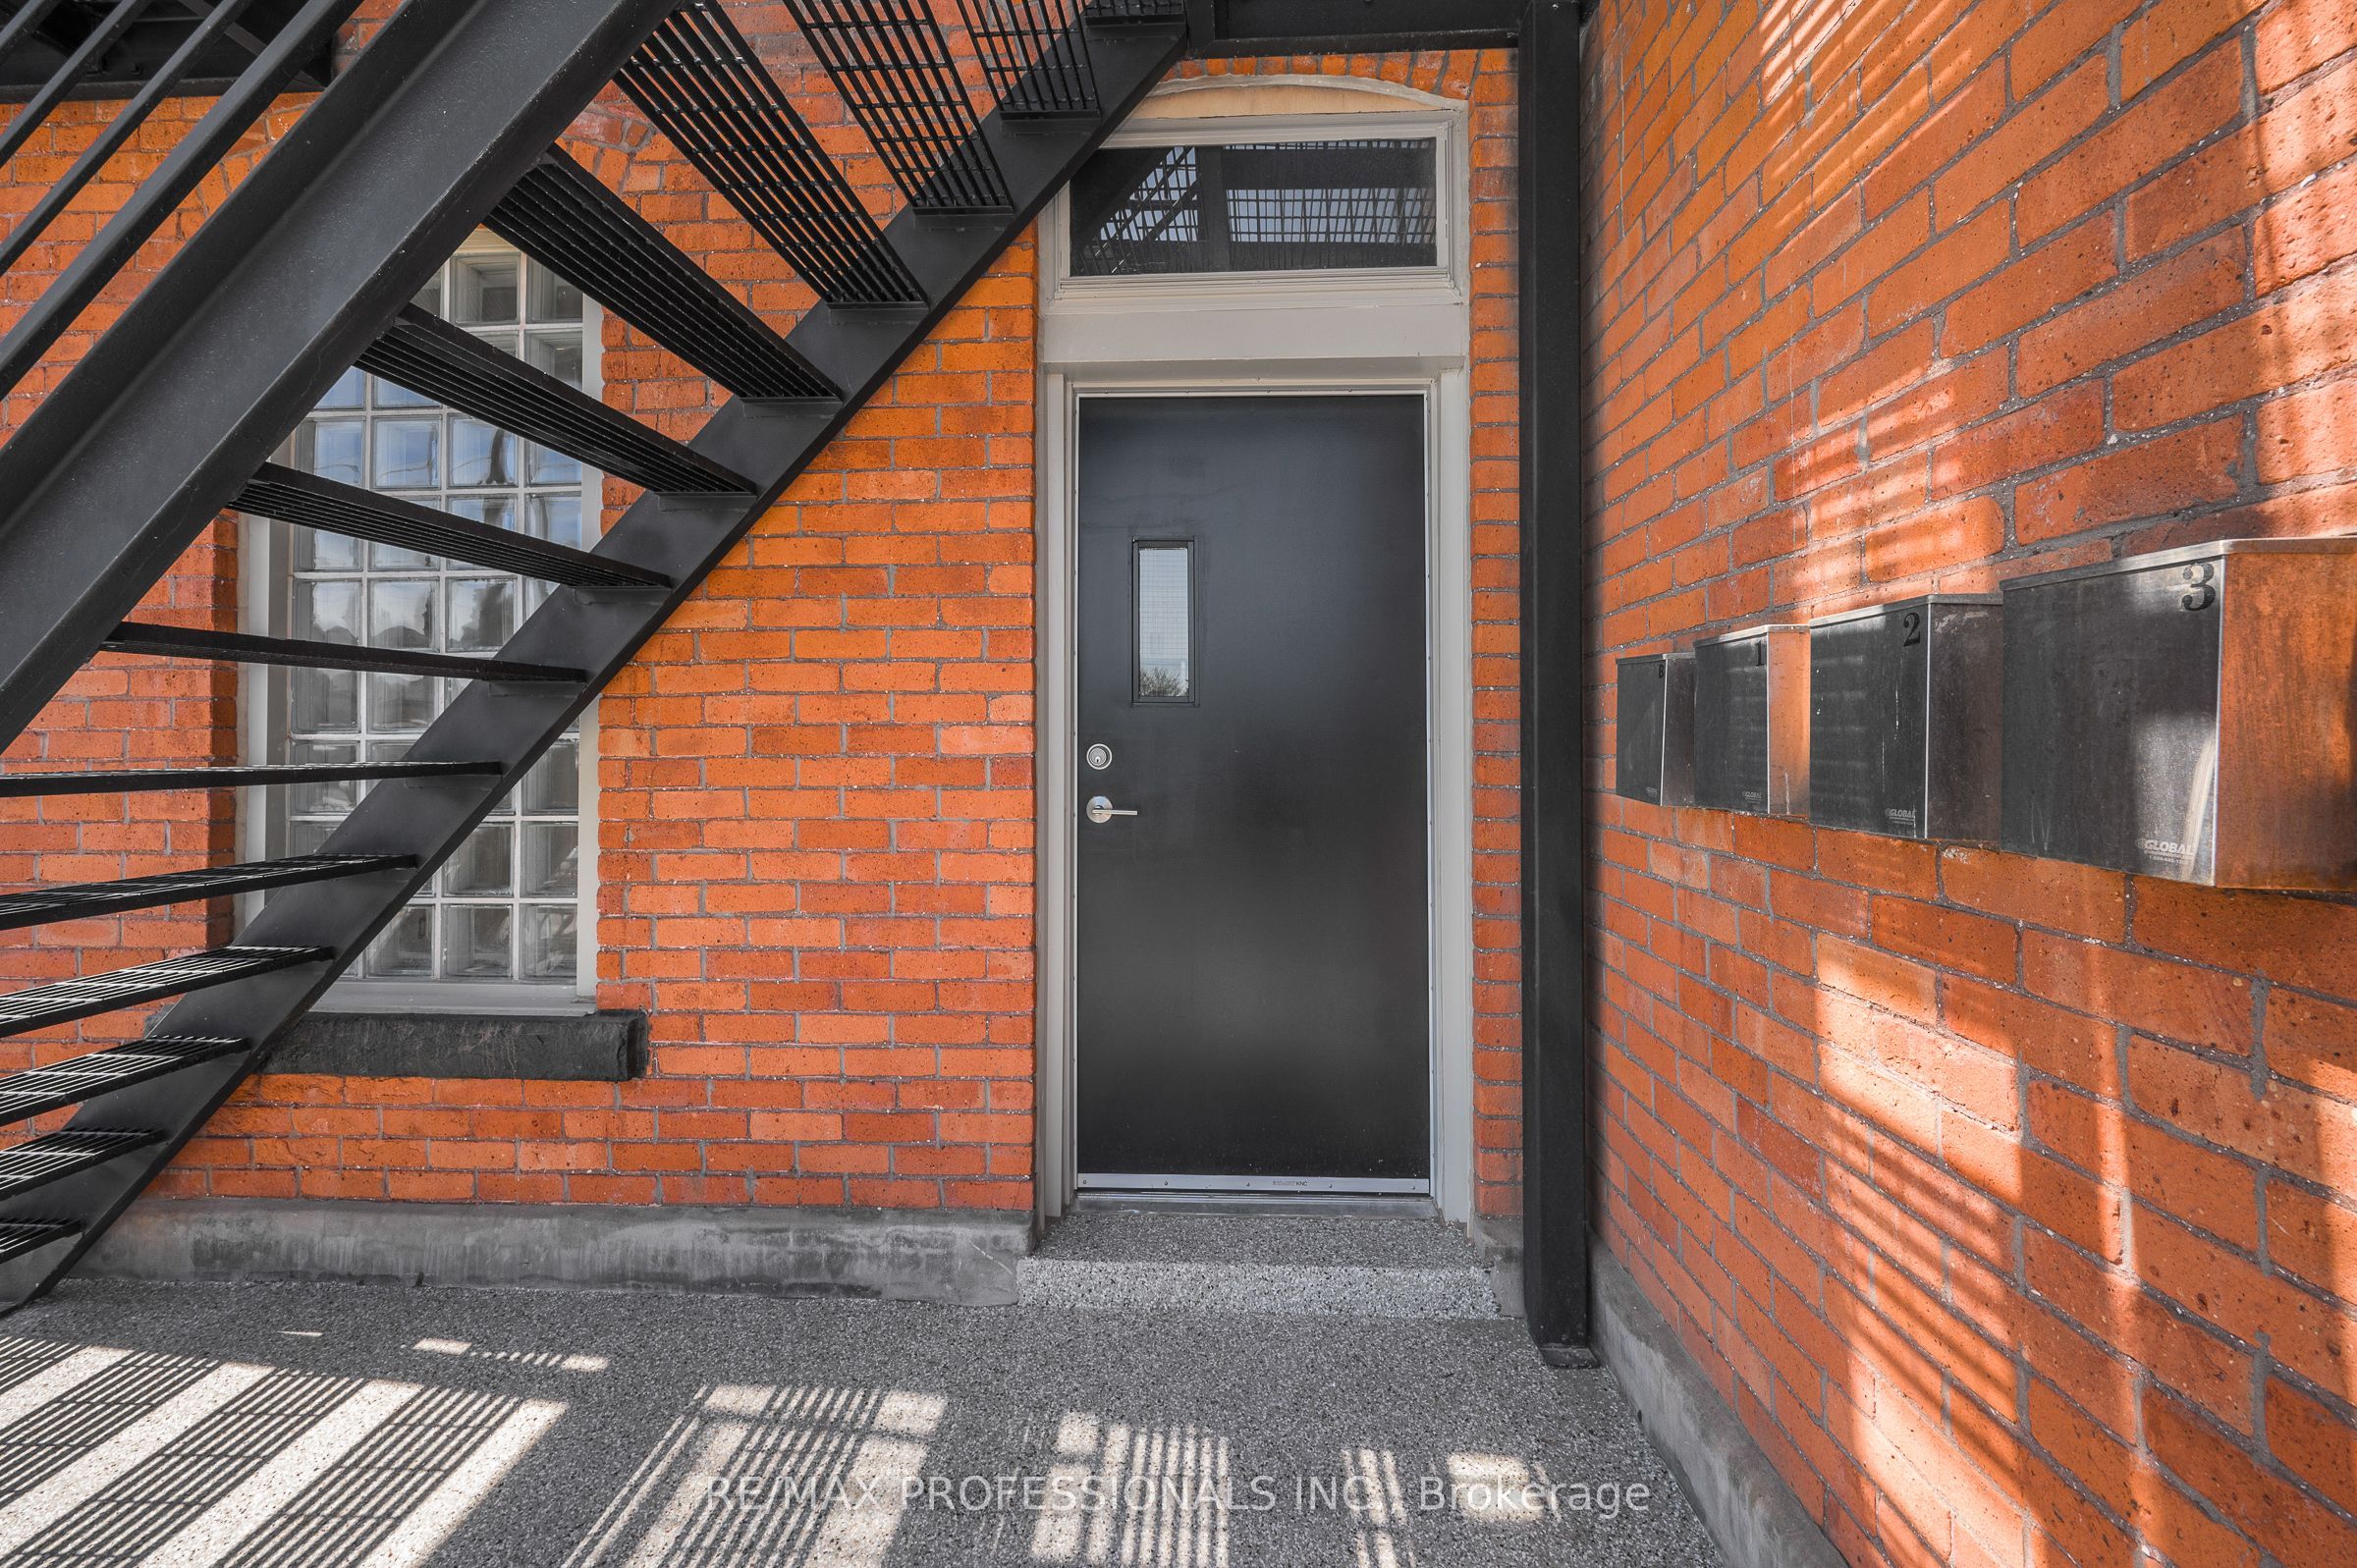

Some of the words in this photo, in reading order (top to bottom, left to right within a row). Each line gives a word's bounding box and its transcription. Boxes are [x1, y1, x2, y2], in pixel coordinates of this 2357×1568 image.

[2182, 562, 2217, 612] 3
[1903, 612, 1922, 648] 2
[1754, 640, 1765, 667] 1
[1889, 808, 1917, 818] GLOBAL
